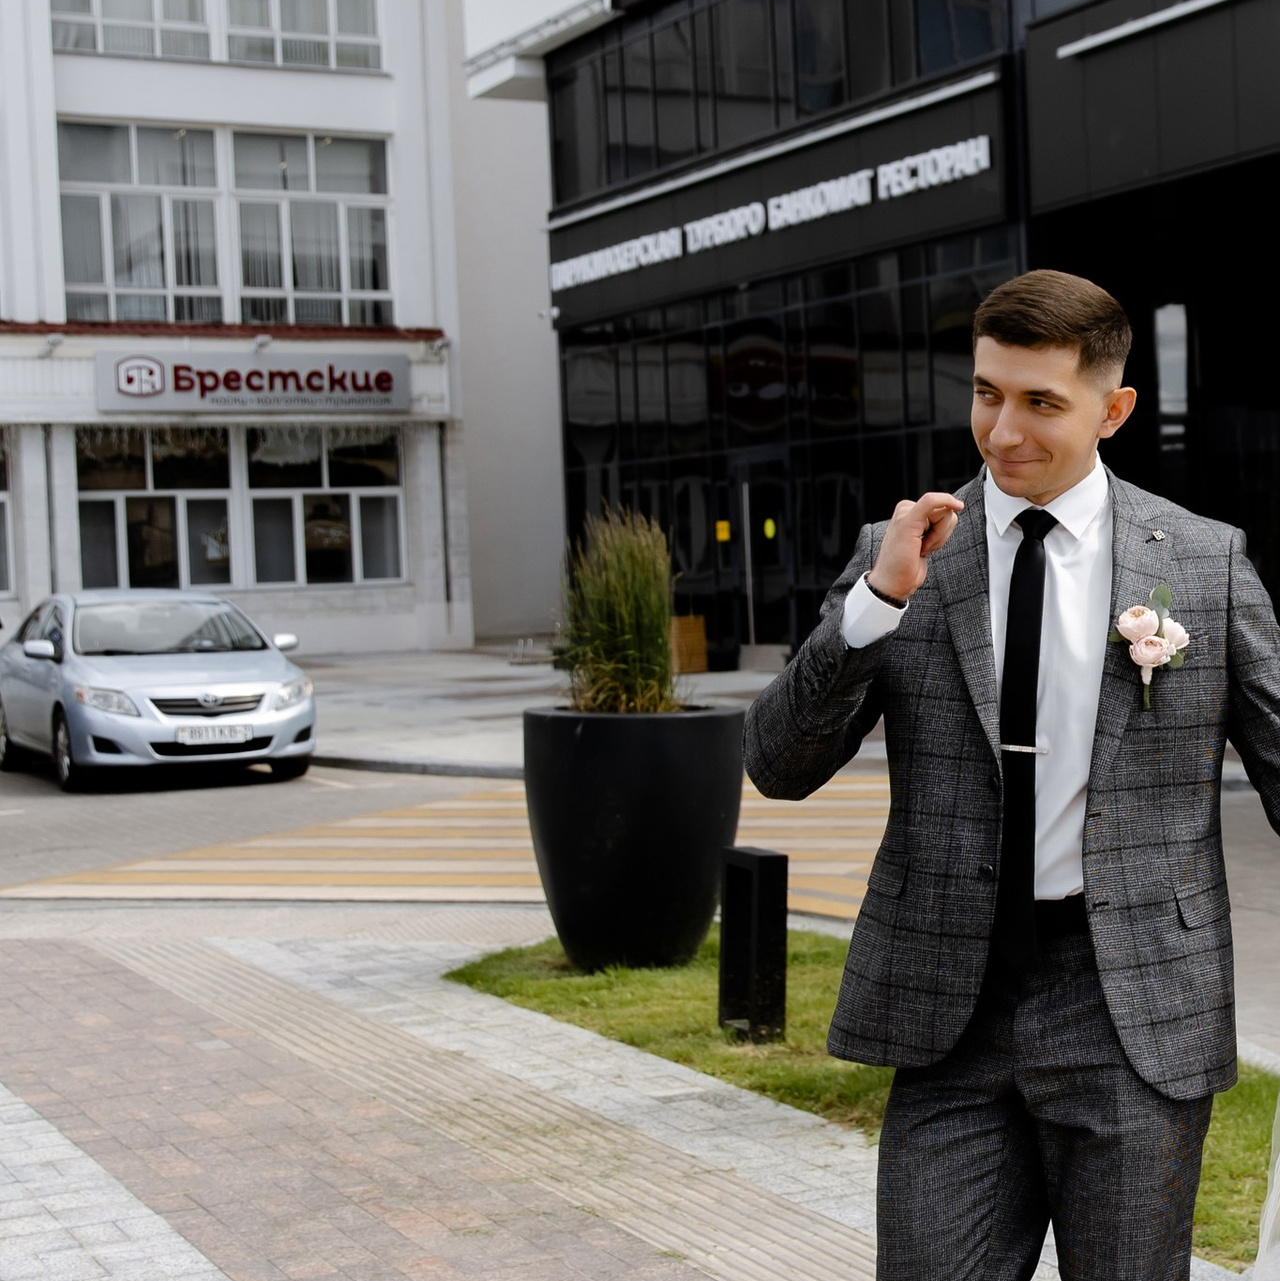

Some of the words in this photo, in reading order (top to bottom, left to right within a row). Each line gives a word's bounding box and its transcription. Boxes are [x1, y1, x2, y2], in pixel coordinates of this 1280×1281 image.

[684, 202, 767, 254] ТУРБЮРО
[767, 168, 874, 231] БАНКОМАТ
[877, 135, 991, 200] РЕСТОРАН
[172, 364, 394, 398] Брестские
